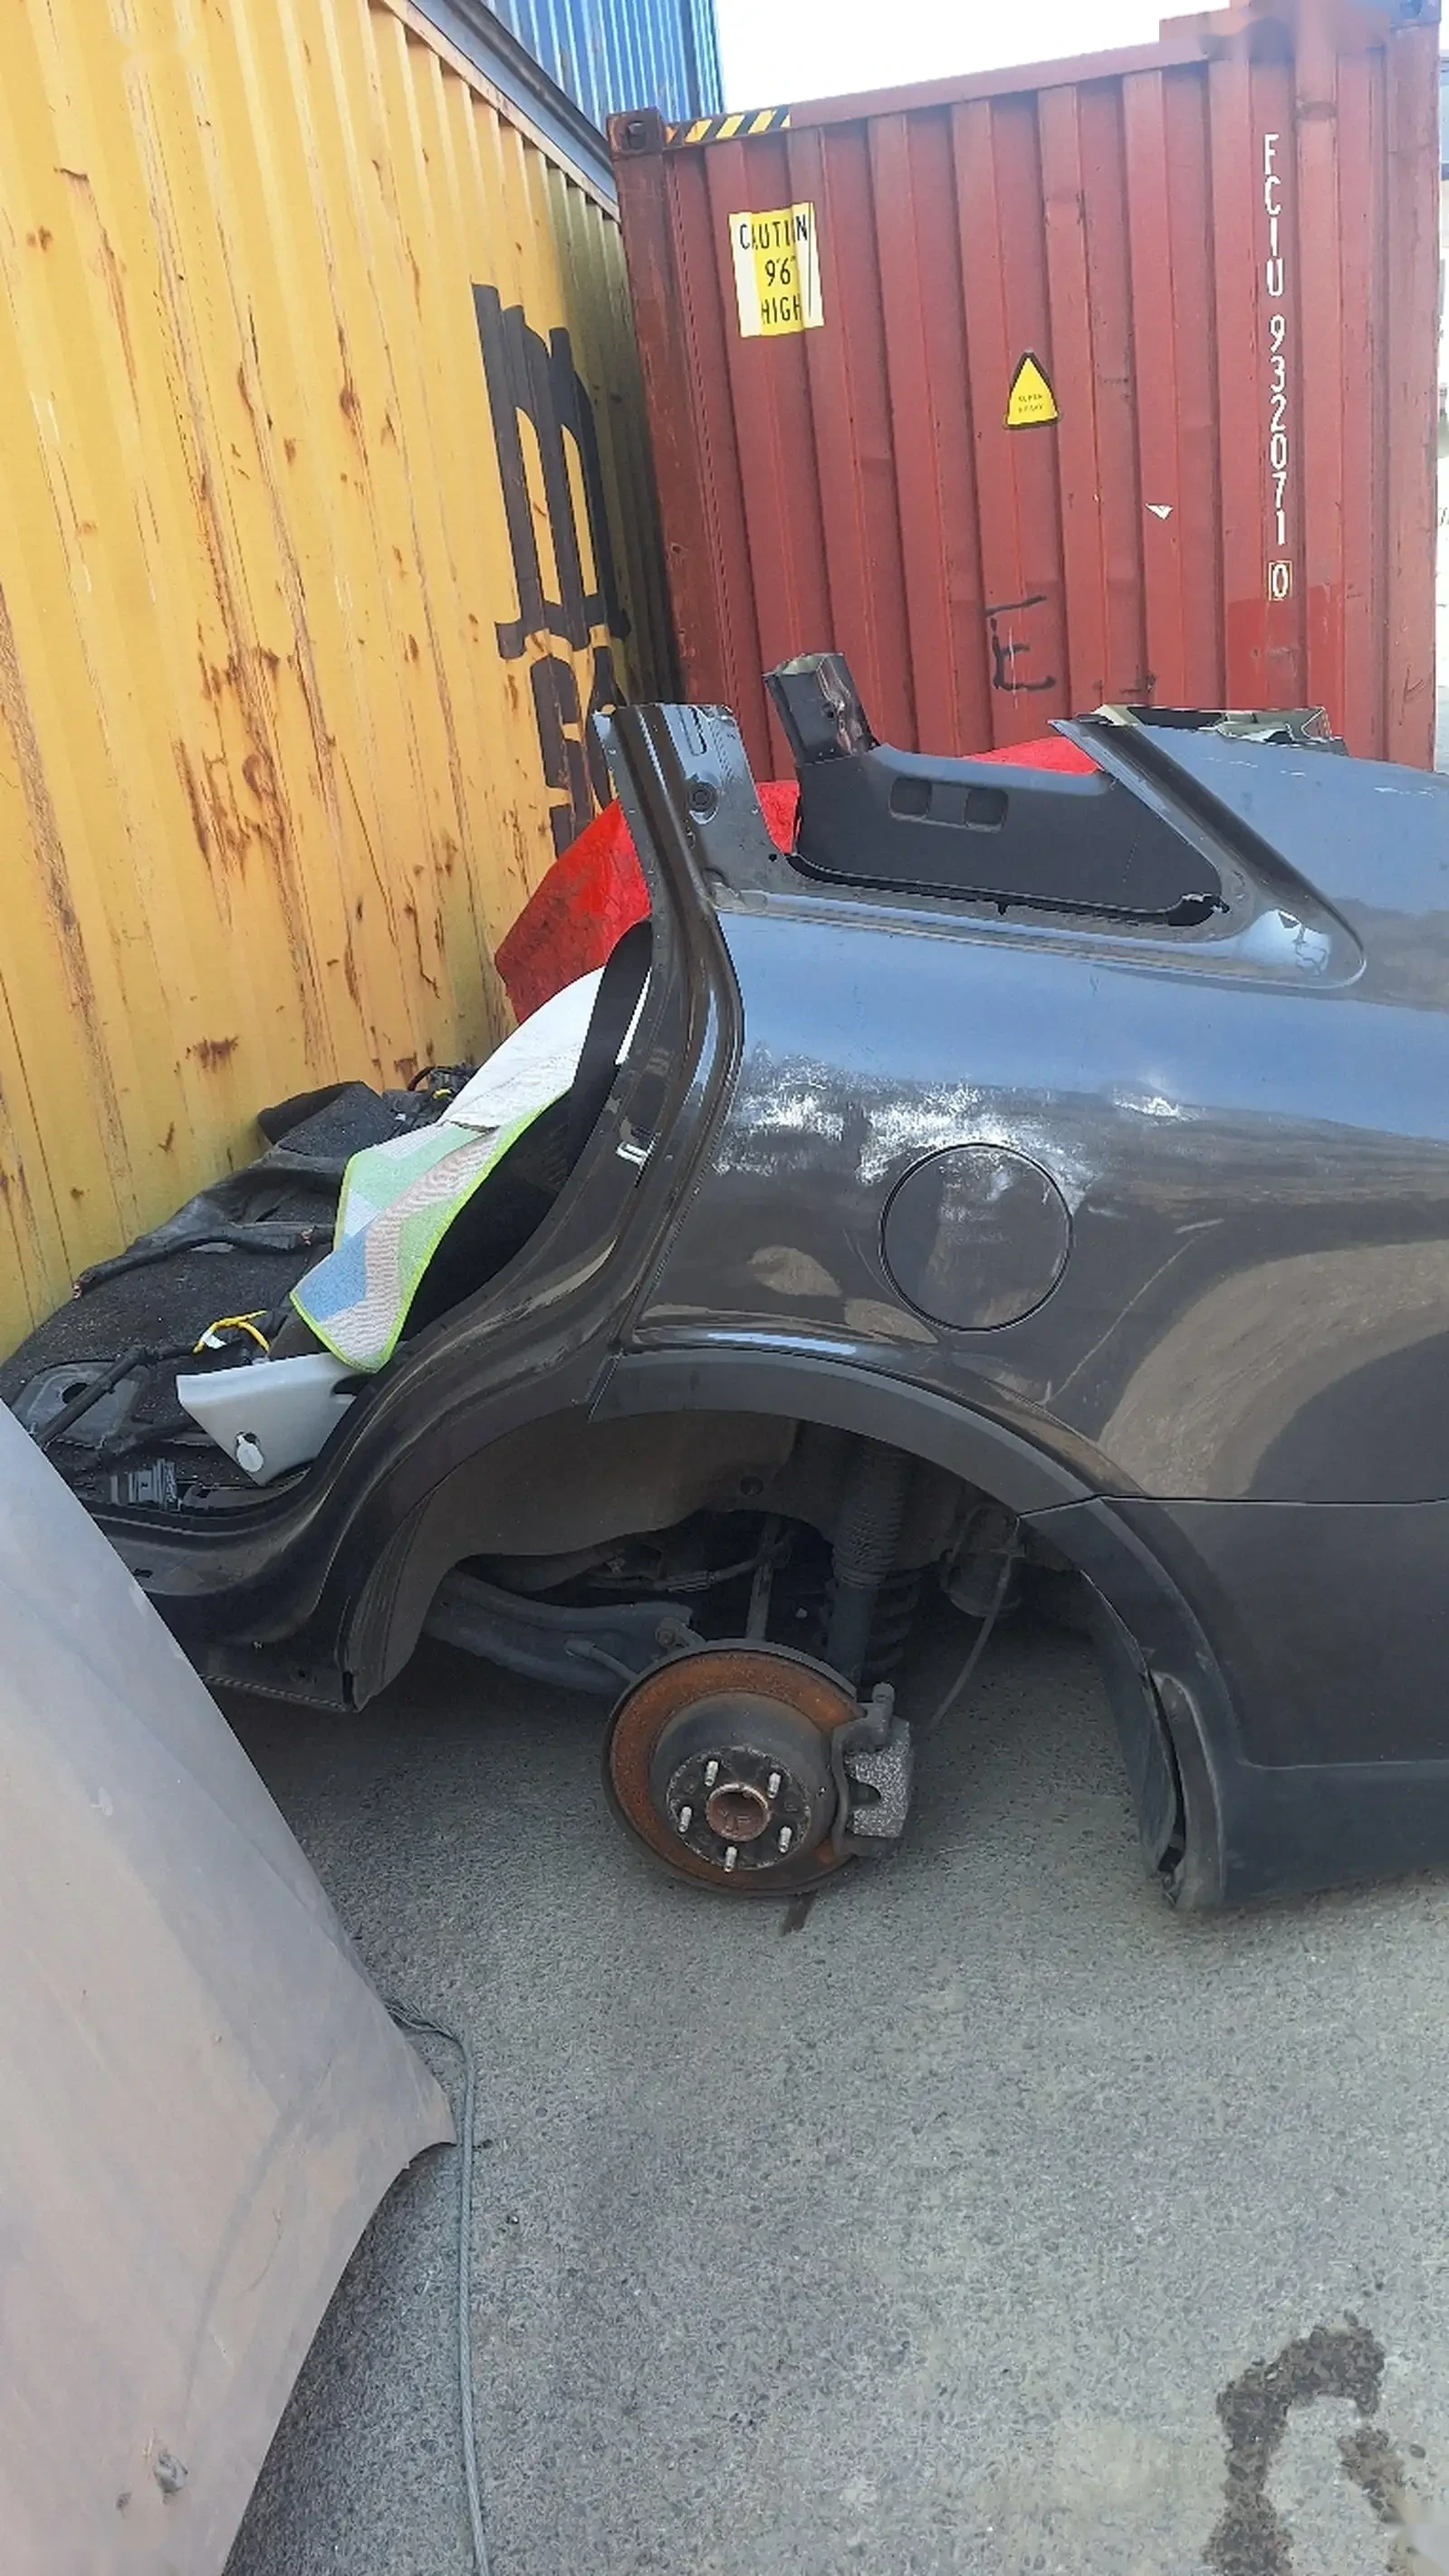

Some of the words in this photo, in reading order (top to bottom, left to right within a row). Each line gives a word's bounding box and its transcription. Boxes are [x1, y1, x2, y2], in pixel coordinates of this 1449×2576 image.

[1263, 133, 1284, 297] FCIU
[761, 293, 801, 325] HIGH
[1270, 313, 1287, 545] 932071
[1271, 562, 1290, 599] 0
